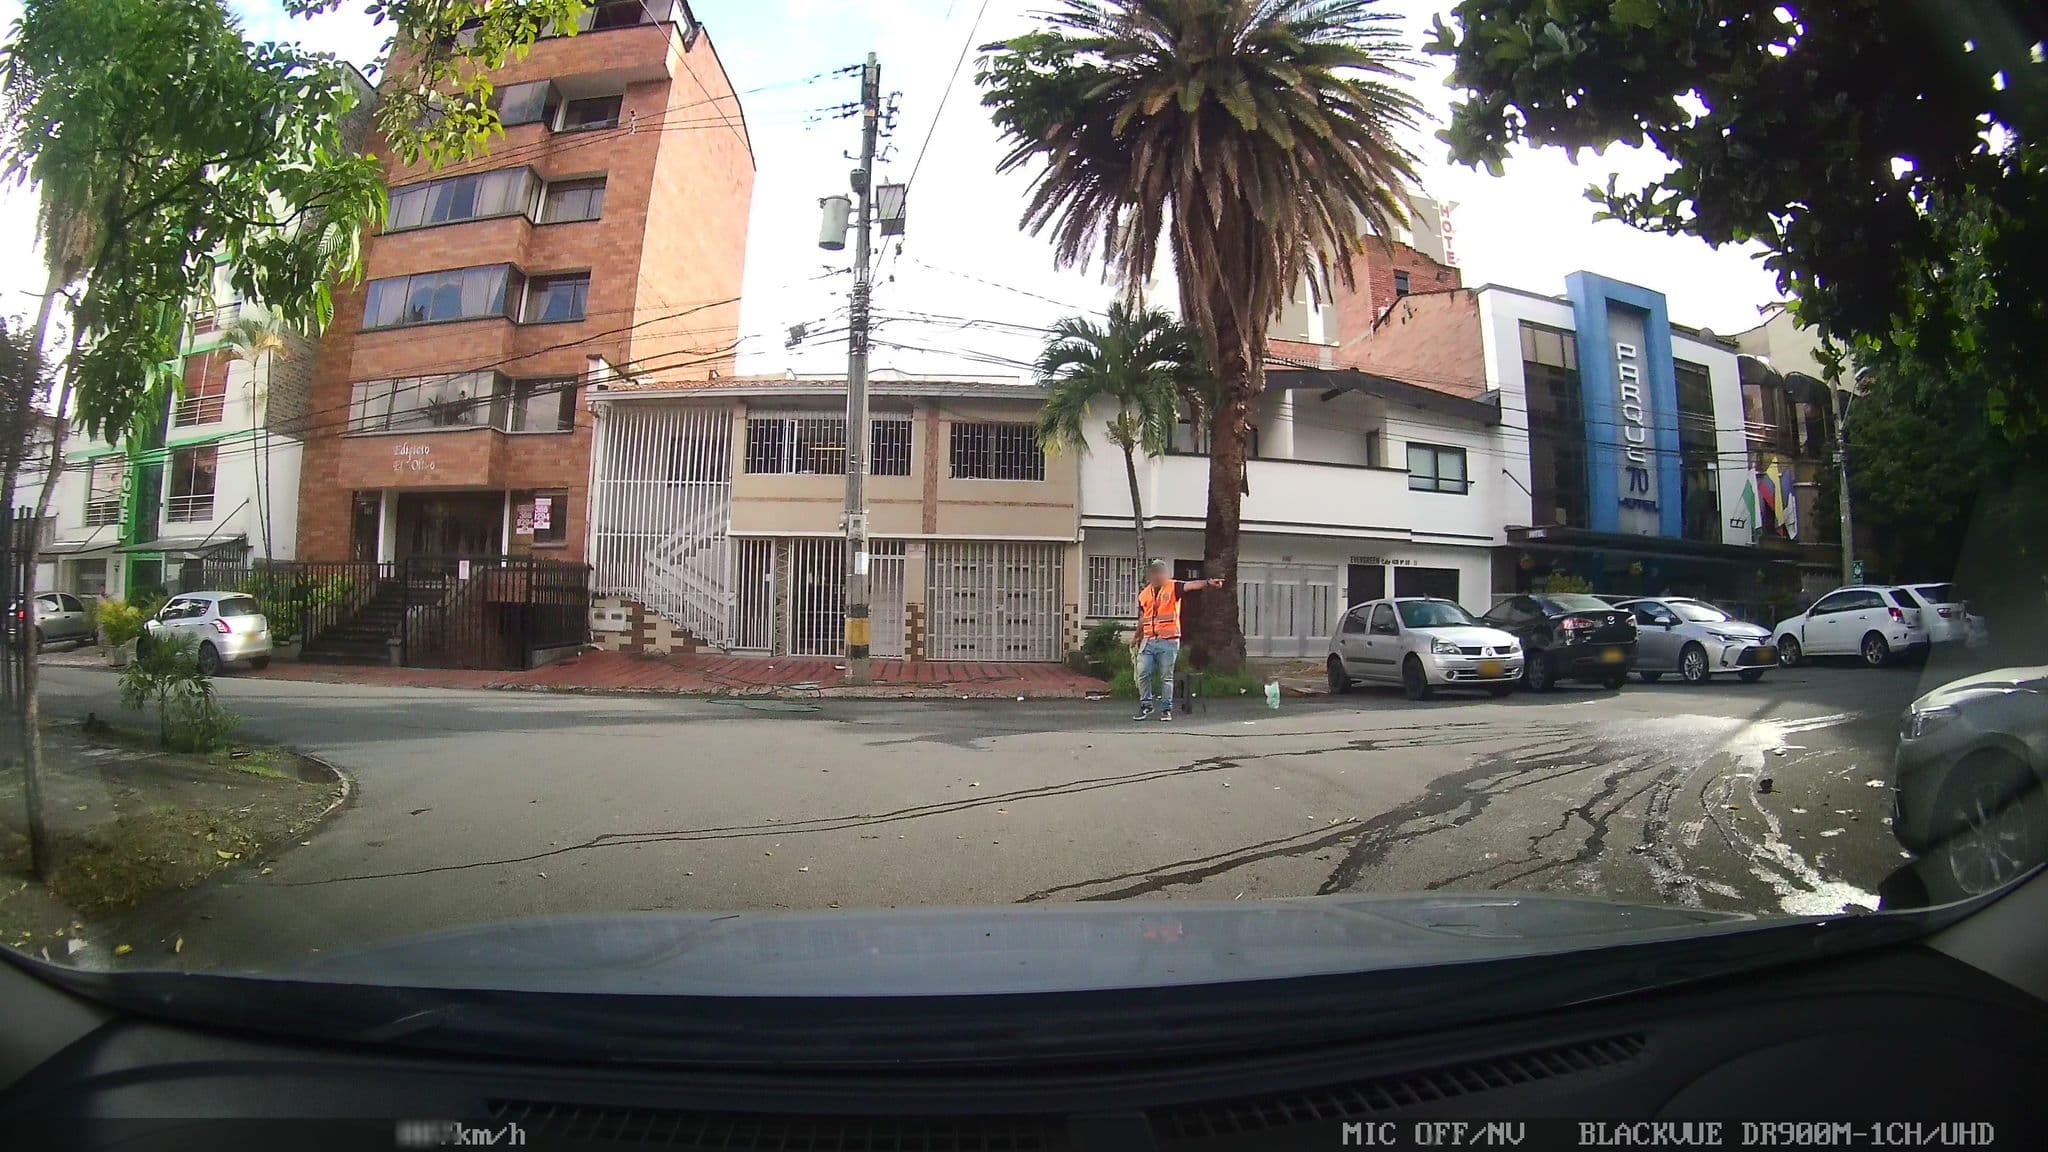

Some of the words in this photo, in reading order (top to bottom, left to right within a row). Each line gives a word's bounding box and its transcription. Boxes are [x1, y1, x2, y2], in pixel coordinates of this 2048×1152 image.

[1439, 204, 1457, 266] HOTE
[1615, 341, 1648, 463] PARQUE
[117, 459, 134, 540] HOTEL
[1625, 465, 1649, 493] 70
